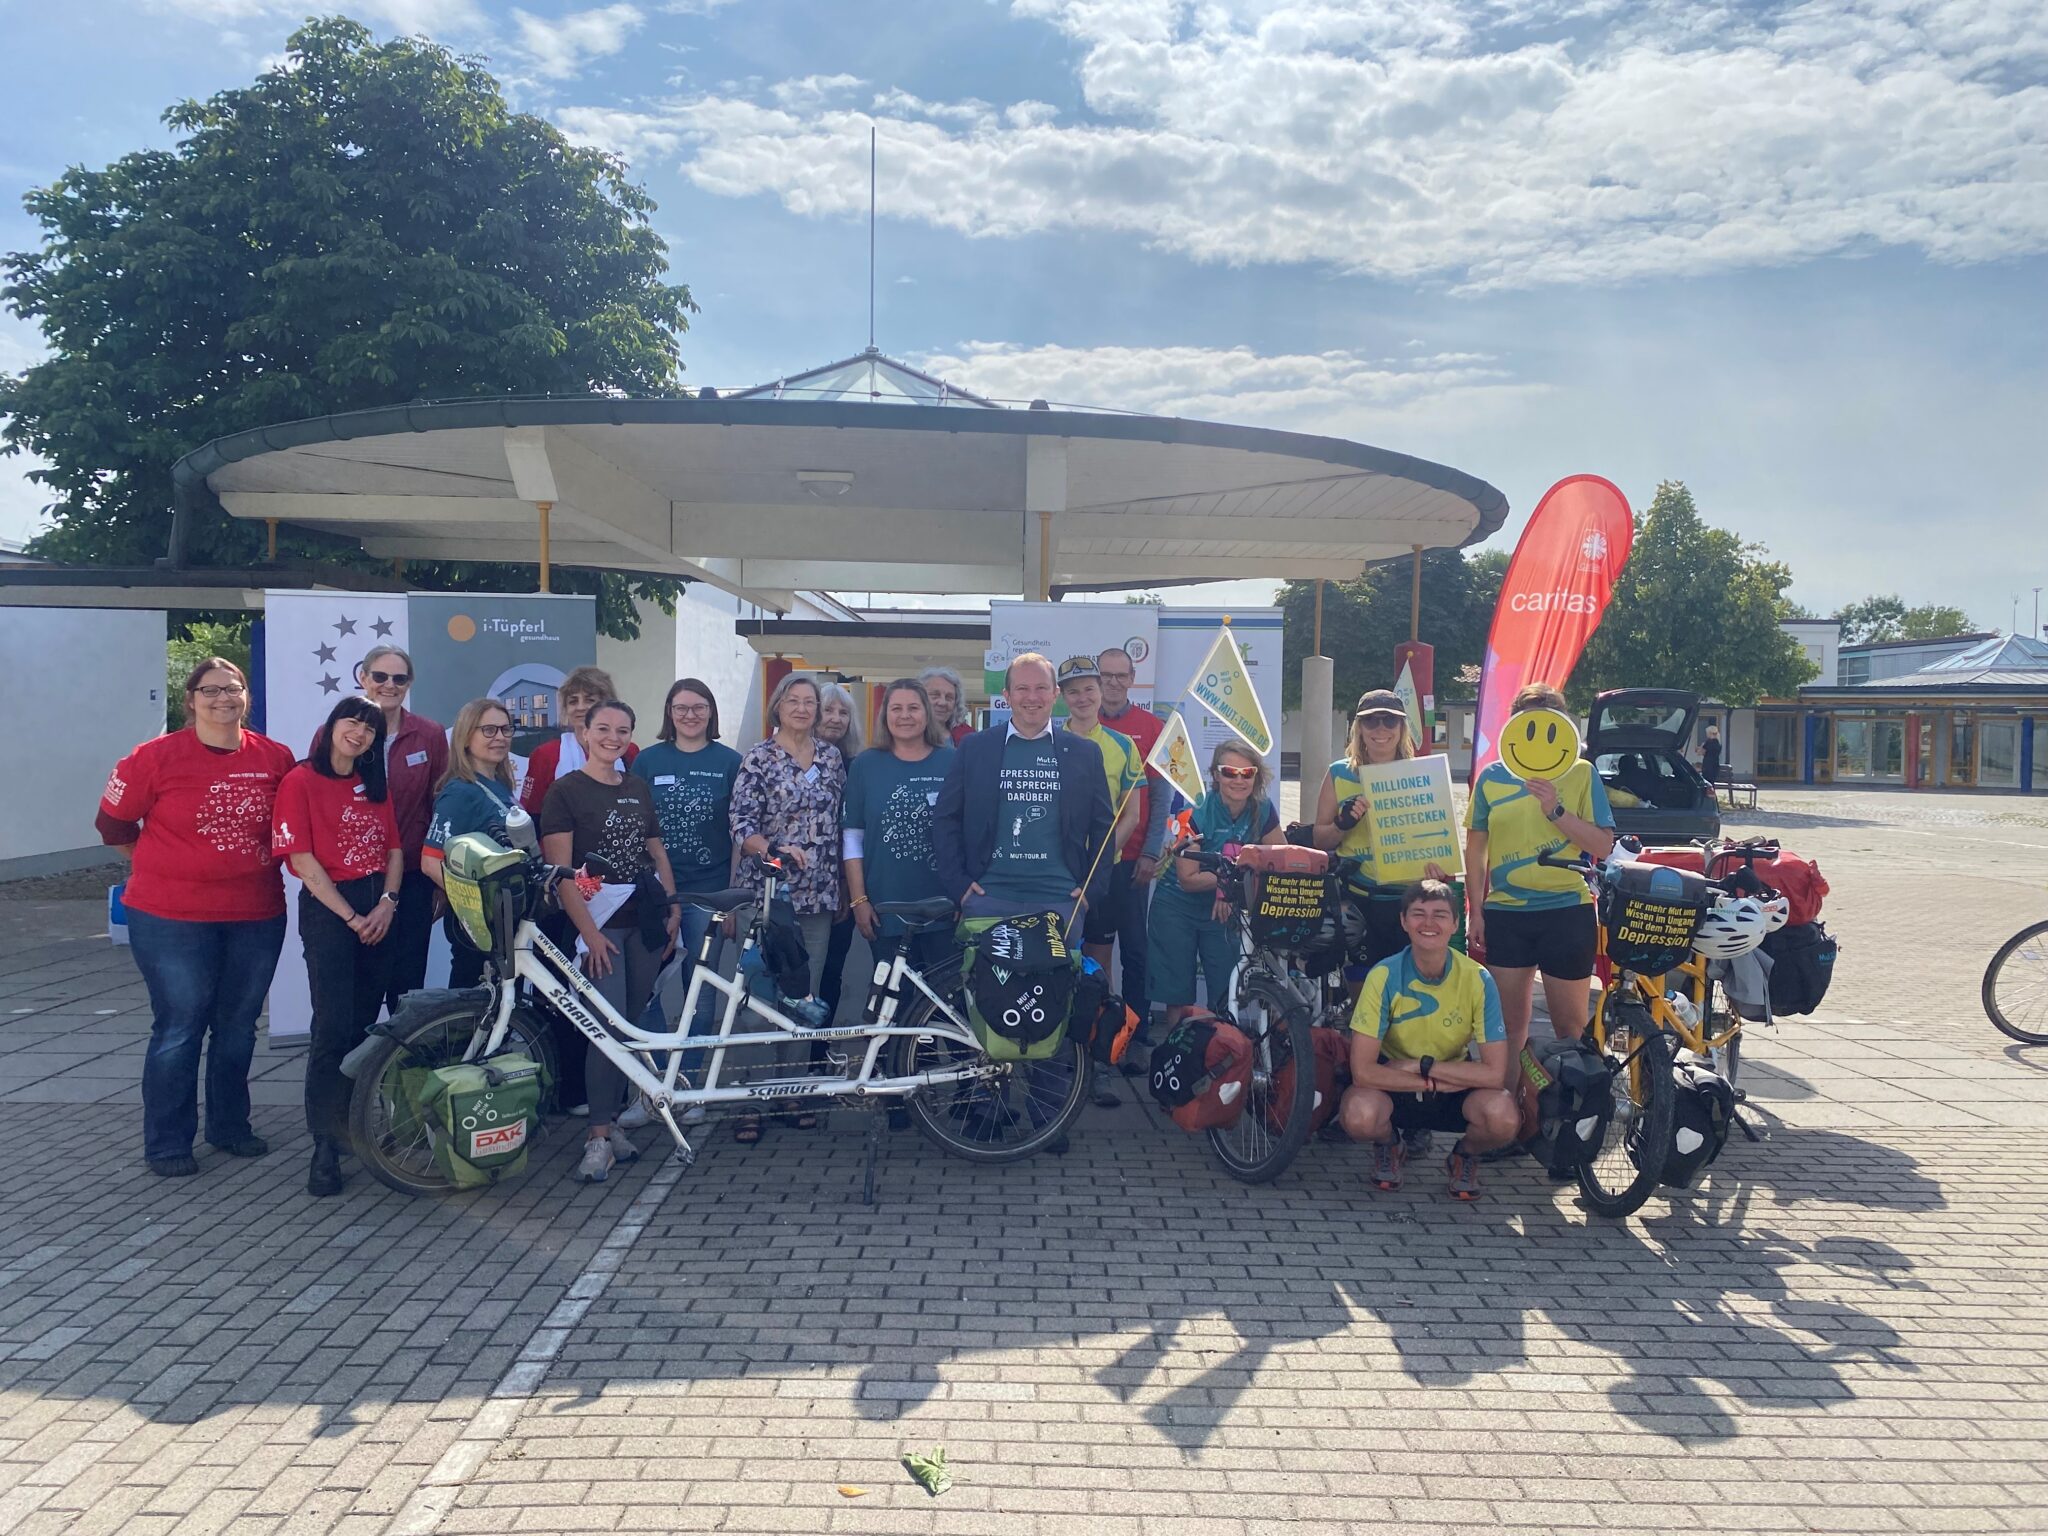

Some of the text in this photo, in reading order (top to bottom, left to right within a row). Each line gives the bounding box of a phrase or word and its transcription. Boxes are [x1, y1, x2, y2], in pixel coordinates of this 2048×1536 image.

[1511, 587, 1597, 614] caritas
[520, 634, 560, 642] gesundhaus
[1196, 682, 1269, 749] WWW.MUT-TOUR.DE
[1000, 769, 1060, 779] EPRESSIONE
[1016, 781, 1061, 790] SPRECHE
[1371, 775, 1432, 794] MILLIONEN
[1007, 791, 1053, 802] DARÜBER!
[1374, 792, 1435, 812] MENSCHEN
[1376, 809, 1447, 829] VERSTECKEN
[1380, 832, 1406, 847] IHRE
[1383, 844, 1453, 864] DEPRESSION
[1502, 852, 1520, 864] MUT
[1268, 875, 1280, 884] Für
[1281, 878, 1298, 886] mehr
[1299, 879, 1311, 887] Mut
[1266, 885, 1324, 897] Wissen im Umgang
[1270, 895, 1318, 905] mit dem Thema
[1260, 902, 1322, 918] Depression
[1629, 900, 1697, 917] Für mehr Mut und
[1625, 908, 1695, 927] Wissen im Umgang
[1630, 920, 1688, 934] mit dem Thema
[1617, 926, 1690, 948] Depression
[538, 932, 593, 991] www.mut-tour.de
[1016, 992, 1030, 1006] MUT
[1021, 997, 1037, 1013] TOUR
[548, 988, 607, 1041] SCHAUFF
[791, 1027, 865, 1039] www.mut-tour.de
[747, 1084, 819, 1098] SCHAUFF
[472, 1099, 483, 1112] MUT
[476, 1121, 523, 1148] DAK
